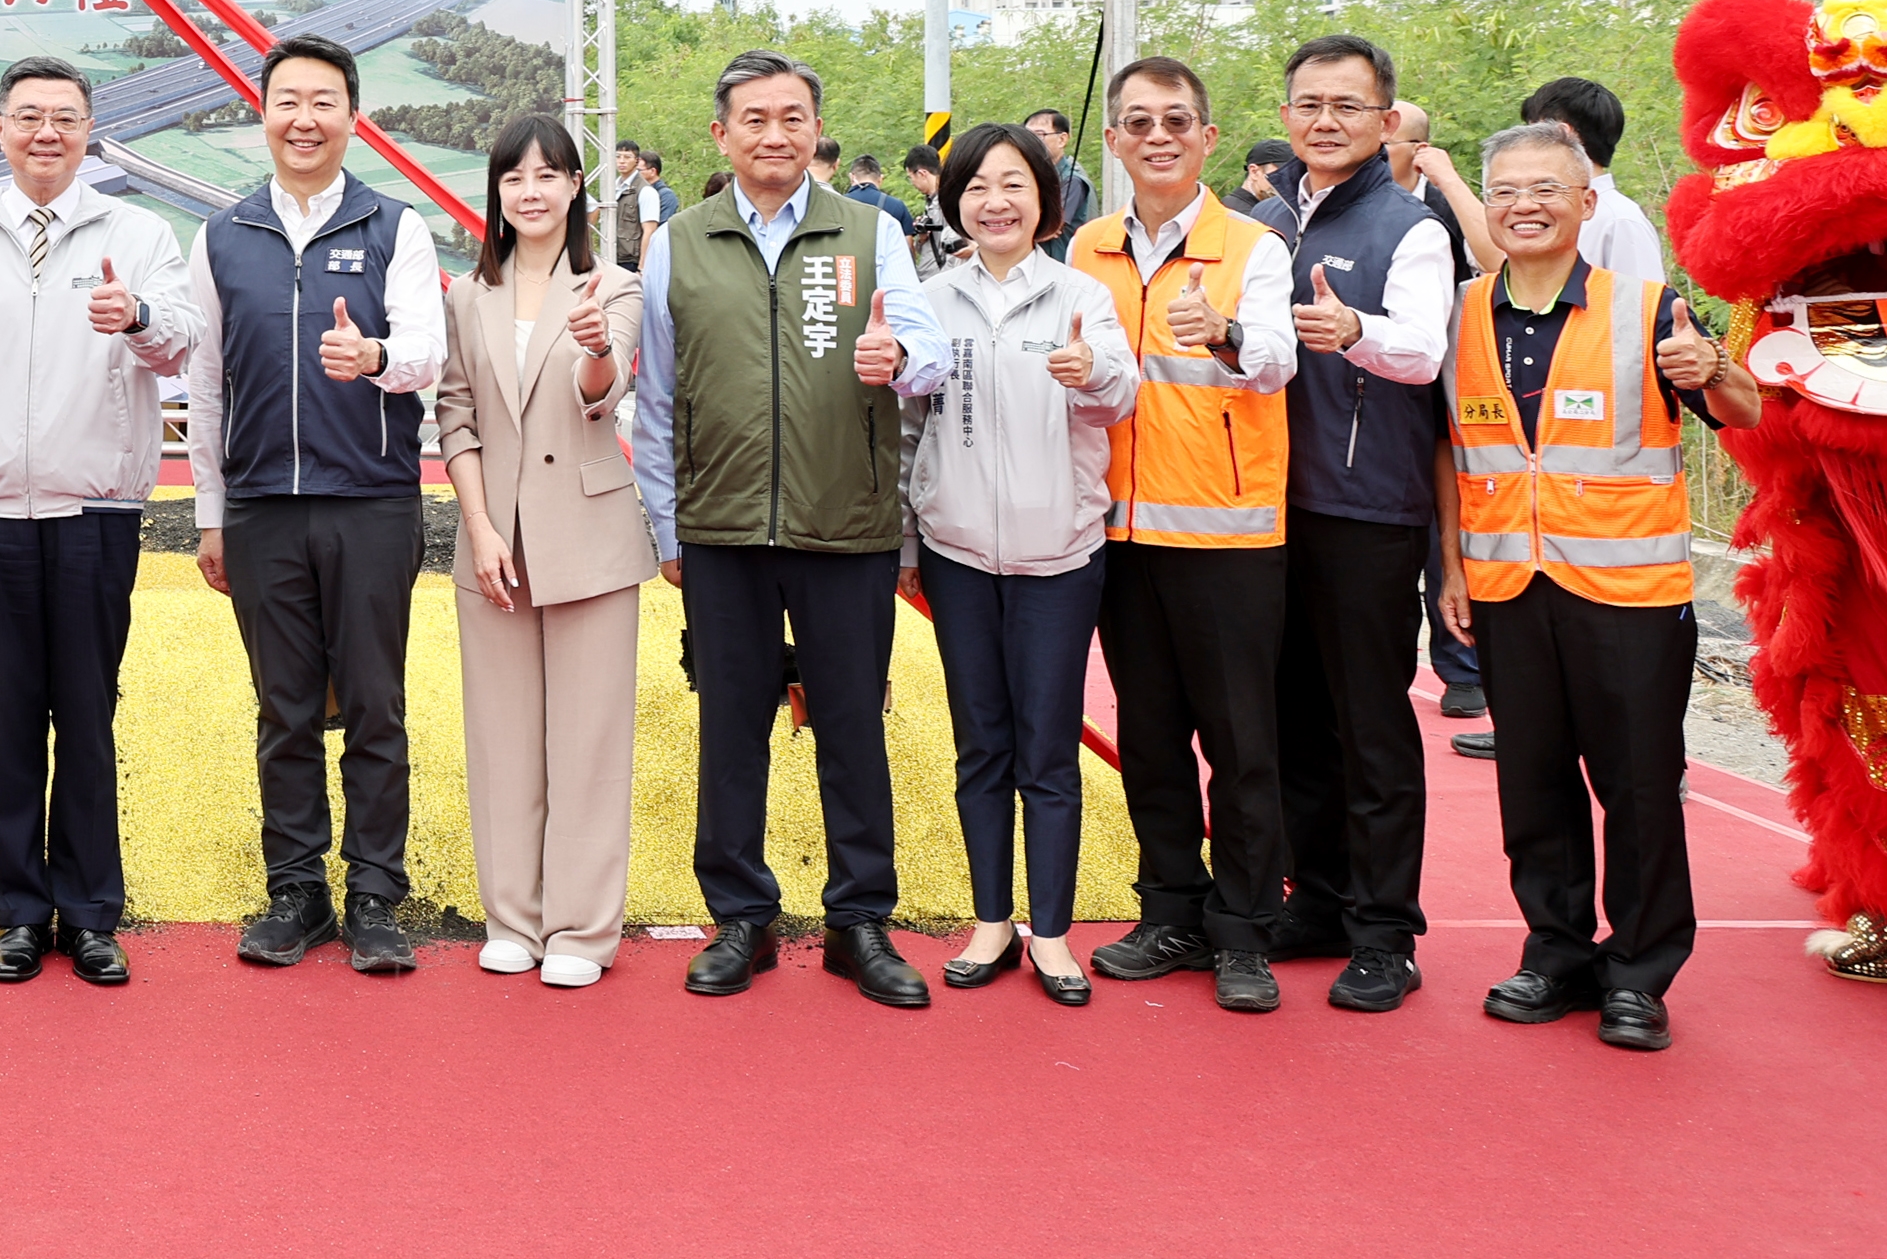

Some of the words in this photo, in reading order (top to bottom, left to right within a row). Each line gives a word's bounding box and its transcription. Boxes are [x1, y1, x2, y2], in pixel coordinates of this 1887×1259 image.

[800, 255, 838, 359] 王定宇
[839, 257, 853, 305] 立法委員
[962, 338, 974, 448] 雲嘉南區聯合服務中心
[1464, 402, 1505, 420] 分局長
